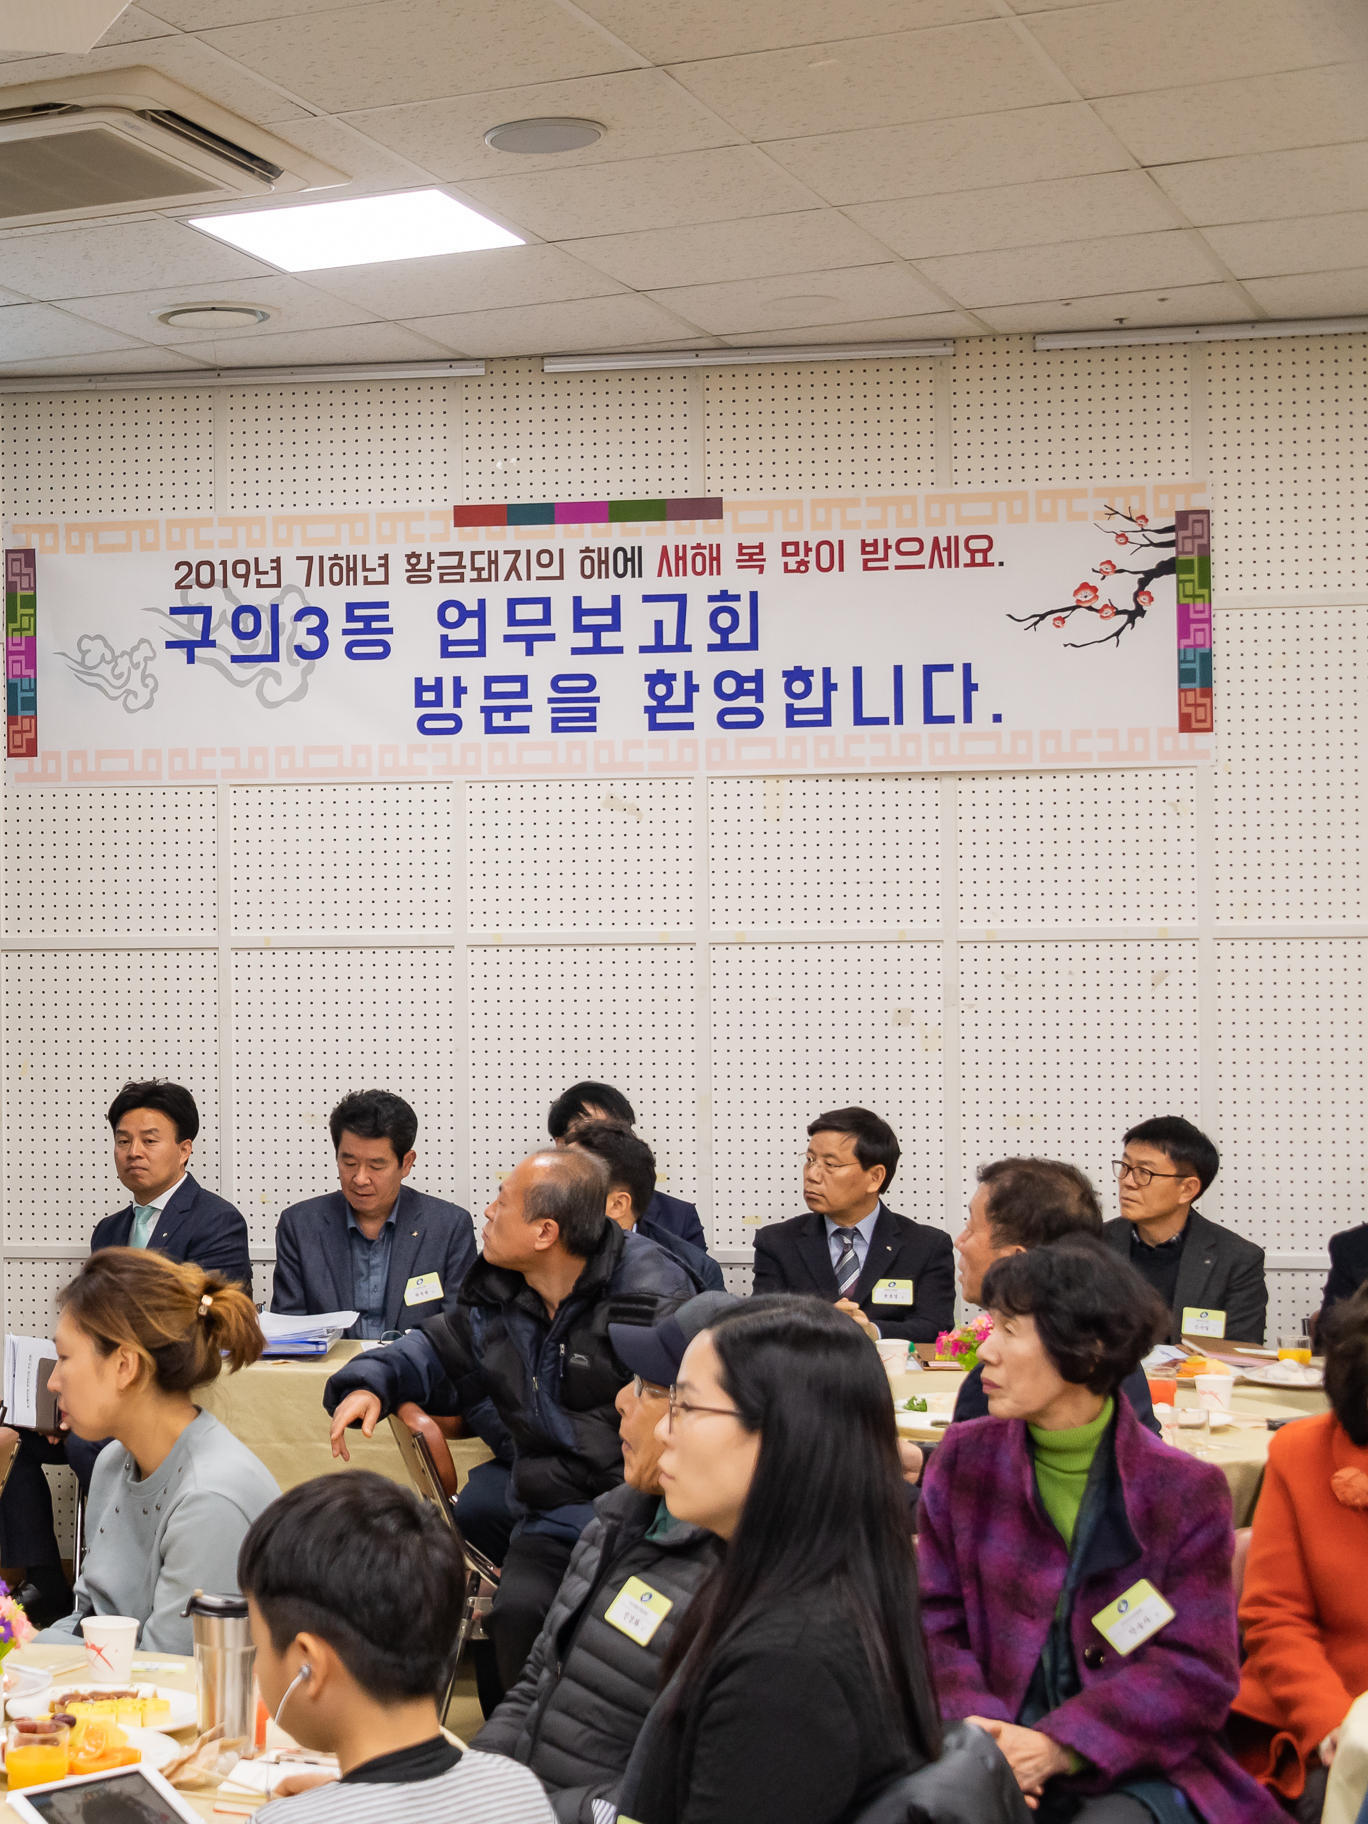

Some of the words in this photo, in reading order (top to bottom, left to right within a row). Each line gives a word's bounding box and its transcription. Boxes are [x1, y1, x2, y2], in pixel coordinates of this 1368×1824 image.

[174, 556, 282, 590] 2019년
[296, 553, 390, 588] 기해년
[404, 548, 564, 585] 황금돼지의
[579, 545, 643, 580] 해에
[656, 543, 721, 578] 새해
[735, 542, 767, 575] 복
[781, 538, 845, 574] 많이
[860, 534, 1004, 572] 받으세요.
[165, 600, 394, 665] 구의3동
[437, 589, 759, 659] 업무보고회
[414, 673, 601, 736] 방문을
[643, 662, 1002, 731] 환영합니다.
